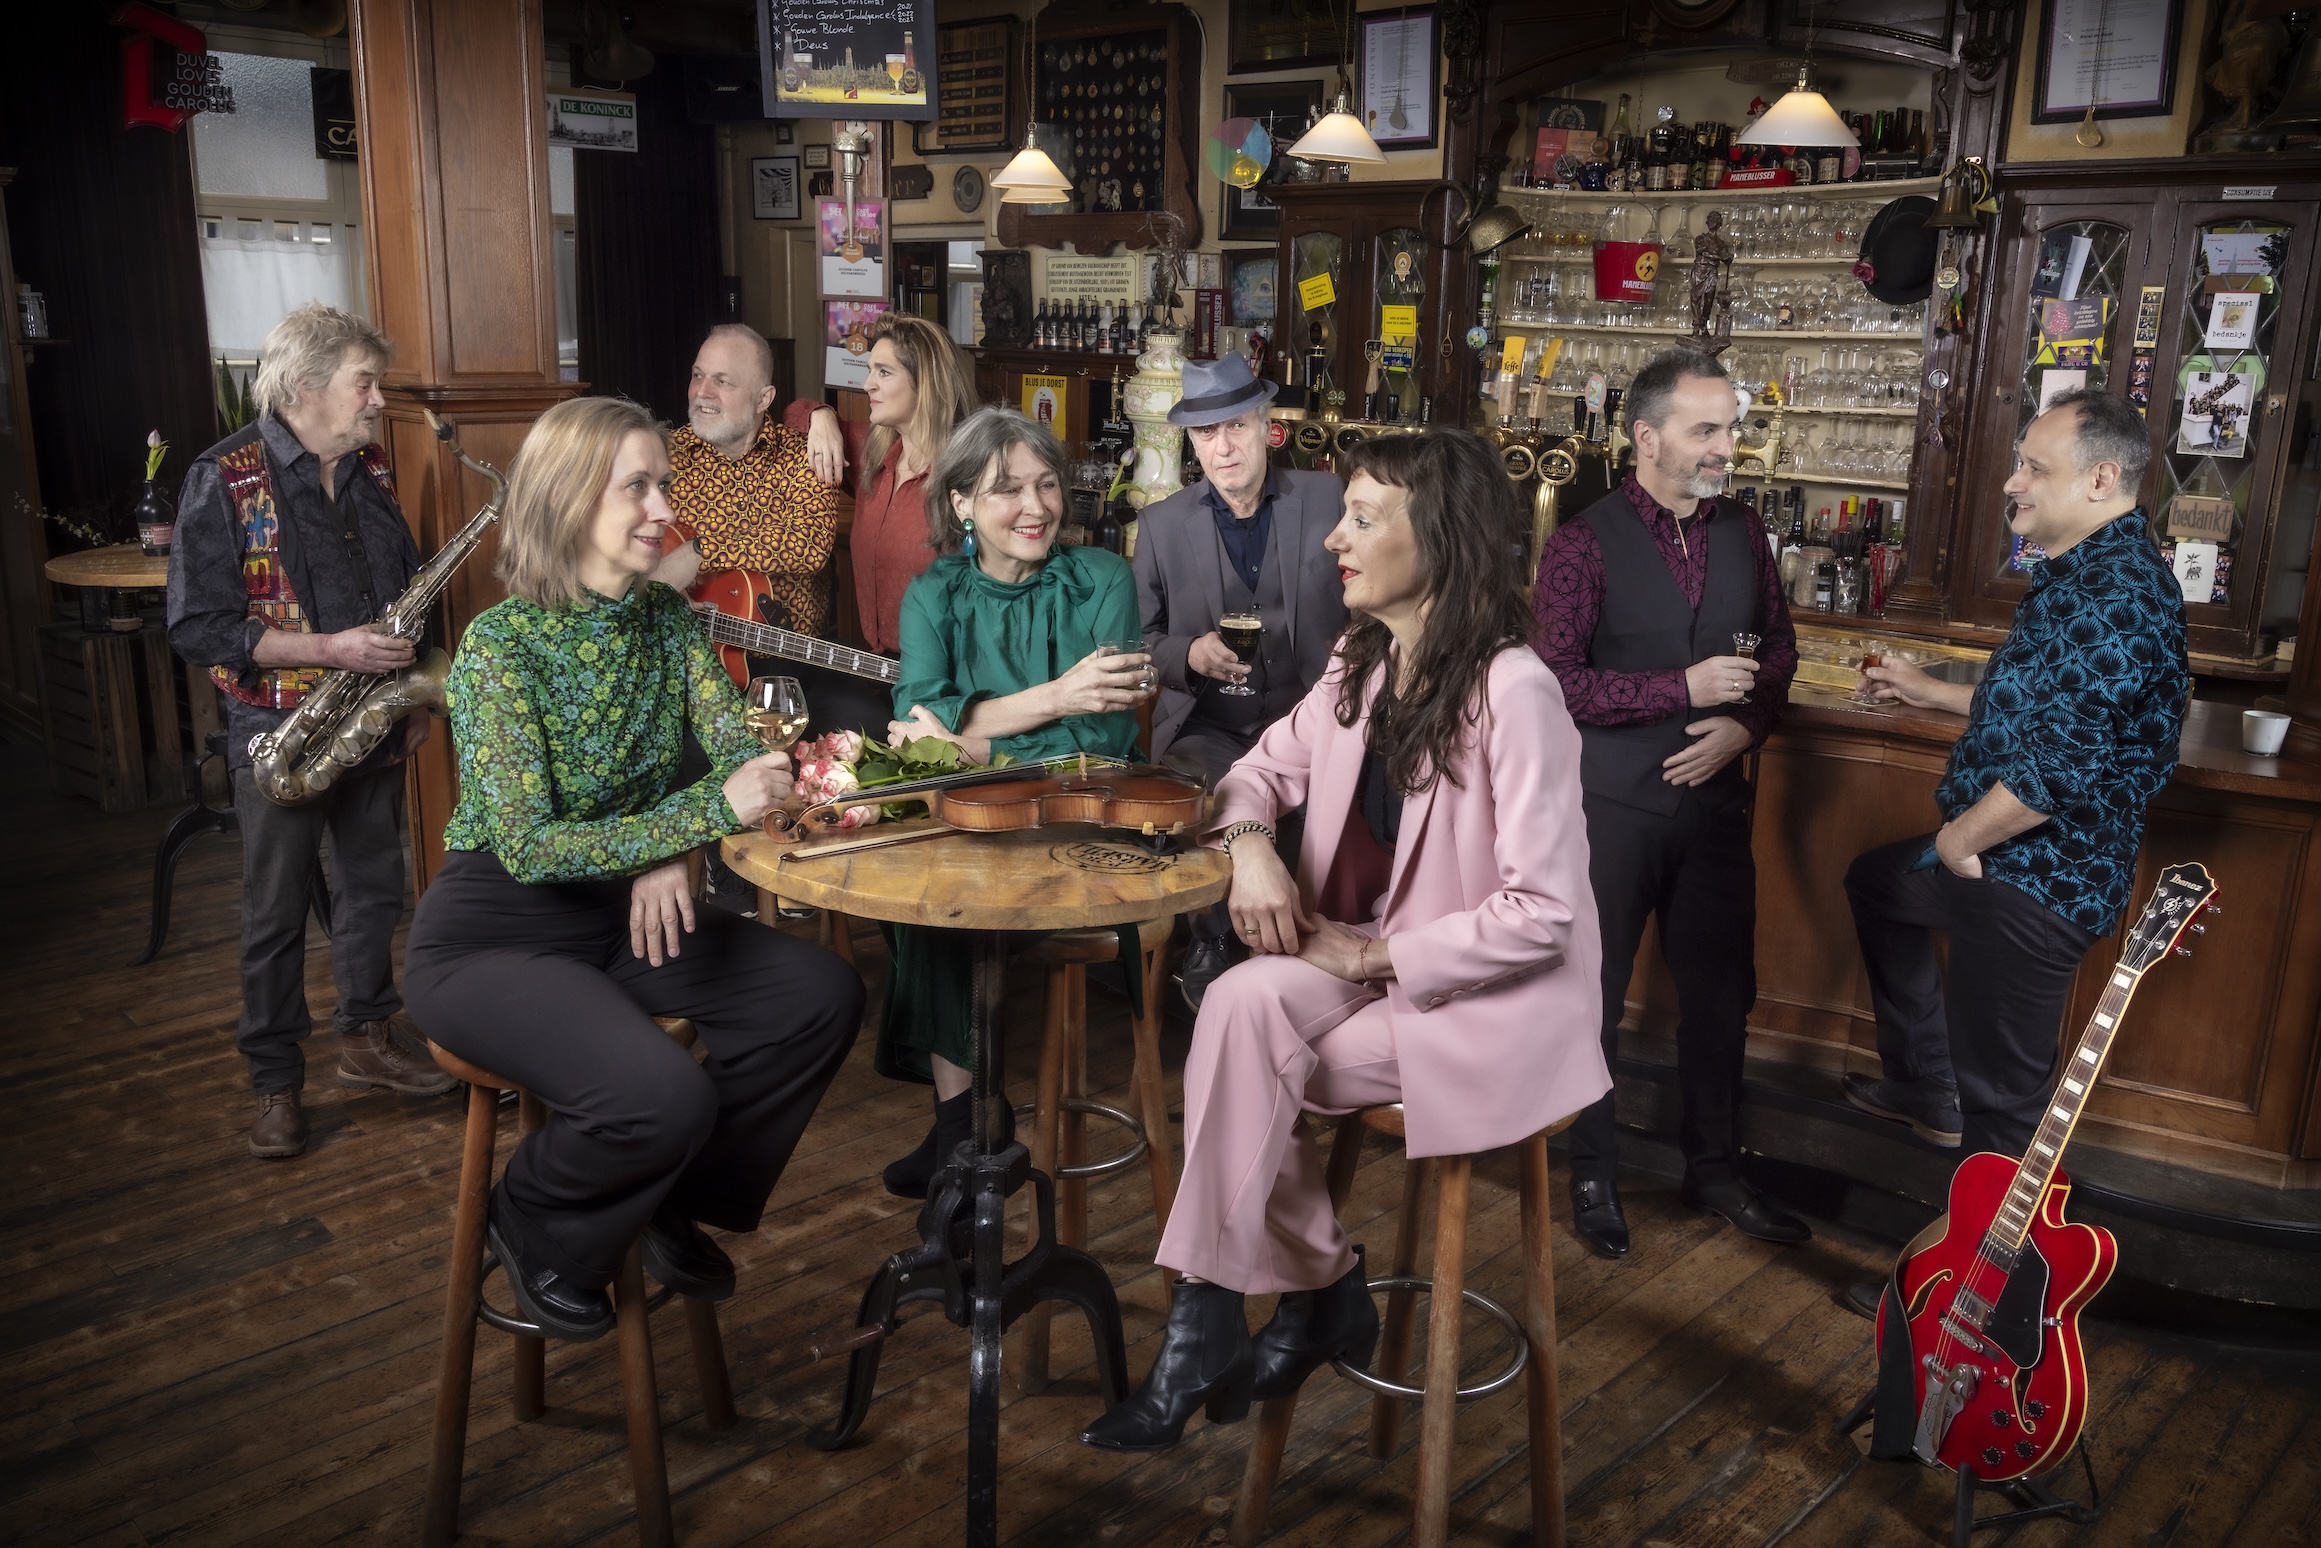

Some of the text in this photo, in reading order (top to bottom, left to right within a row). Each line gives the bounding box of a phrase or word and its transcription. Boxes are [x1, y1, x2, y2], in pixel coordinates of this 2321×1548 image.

[783, 9, 814, 26] Gouden
[2061, 0, 2073, 50] ONDE
[819, 22, 855, 34] Blonde
[794, 39, 829, 51] Deus
[176, 53, 224, 71] DUVEL
[1369, 28, 1377, 97] OORKONDE
[176, 67, 221, 84] LOVES
[167, 82, 233, 100] GOUDEN
[165, 96, 237, 114] CAROLUS
[563, 101, 632, 117] DE KONINCK
[1729, 171, 1776, 182] MANEBLUSSER
[2212, 330, 2247, 339] bedankje
[850, 341, 864, 352] 18
[1503, 360, 1519, 373] Leffe
[1025, 377, 1065, 388] BLUS JE DORST
[1542, 466, 1570, 475] CAROLUS
[2172, 501, 2232, 535] bedankt
[2169, 873, 2204, 892] Ibanez
